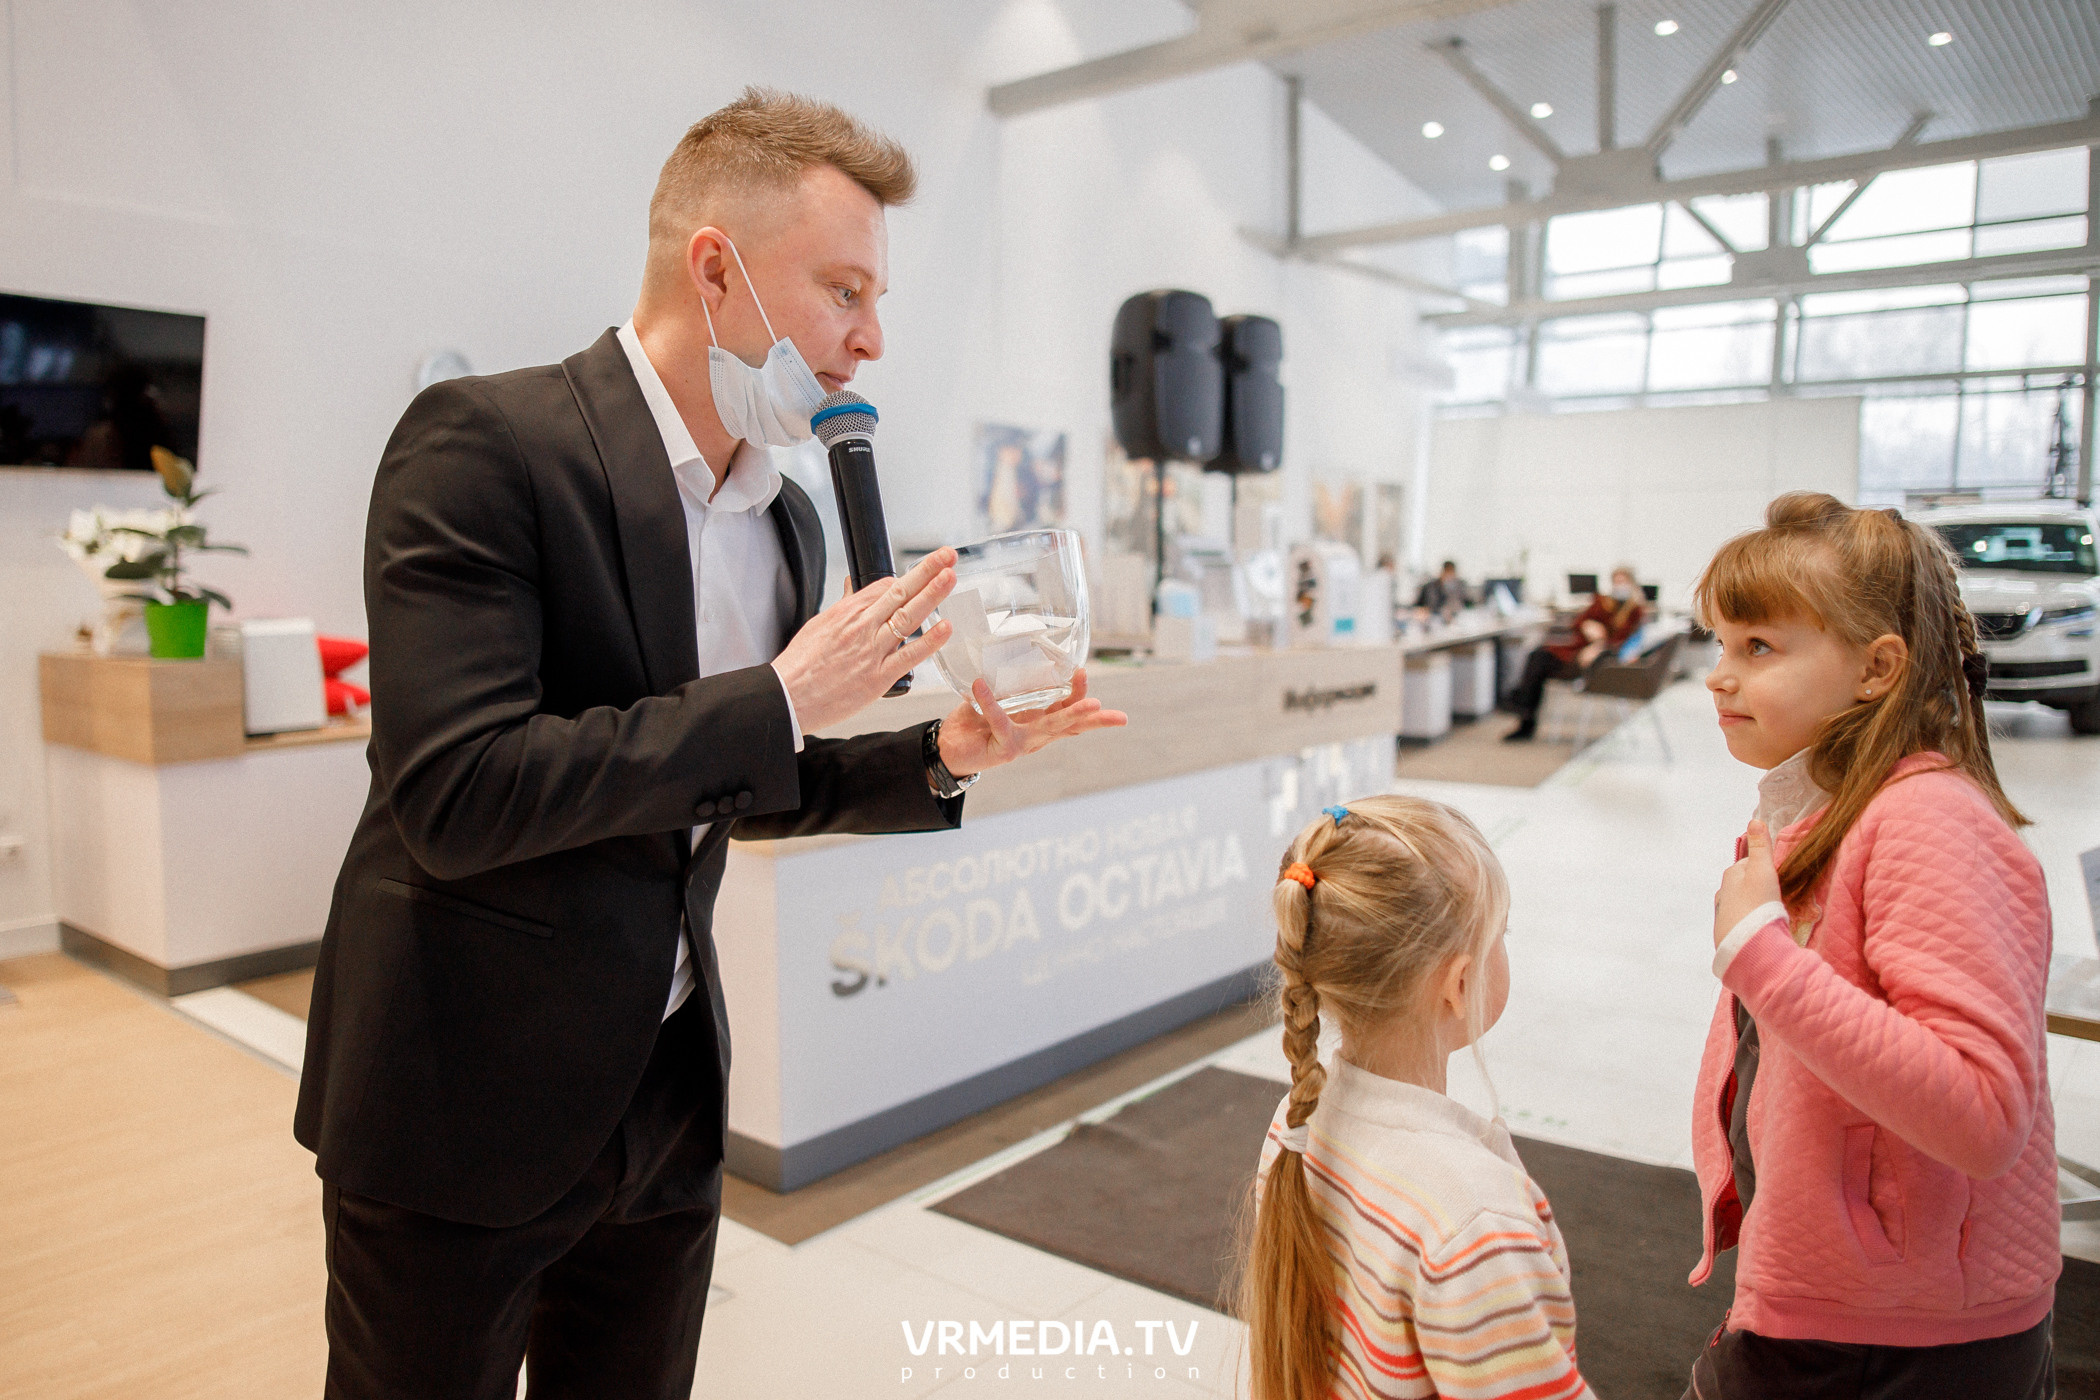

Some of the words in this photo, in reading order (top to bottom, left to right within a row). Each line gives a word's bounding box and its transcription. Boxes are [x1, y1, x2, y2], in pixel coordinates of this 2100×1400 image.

[828, 888, 1041, 998] ŠKODA
[1057, 833, 1249, 932] OCTAVIA
[876, 827, 1101, 914] АБСОЛЮТНО
